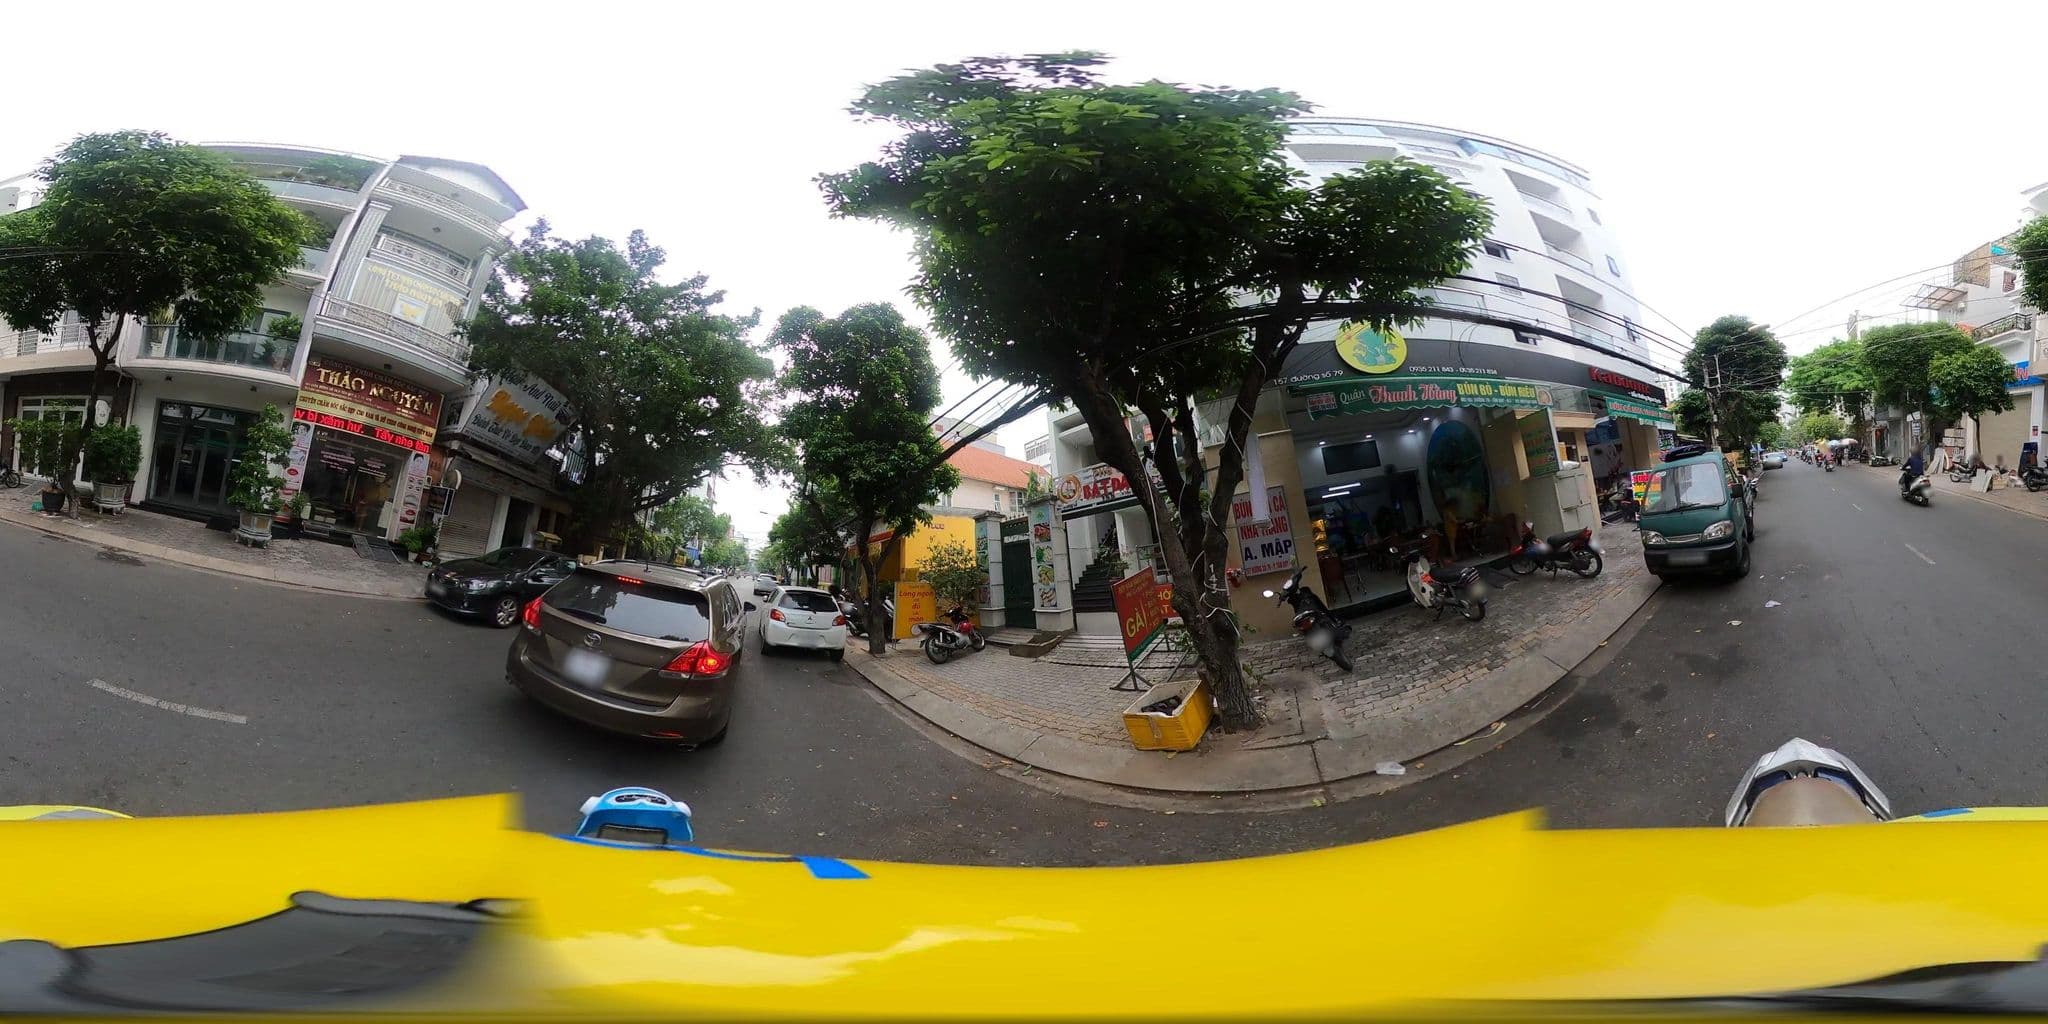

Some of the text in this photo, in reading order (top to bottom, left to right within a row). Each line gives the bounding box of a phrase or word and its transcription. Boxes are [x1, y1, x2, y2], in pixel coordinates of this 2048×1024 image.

[317, 368, 365, 392] THẢO
[370, 384, 433, 414] NGUYÊN
[1340, 388, 1366, 404] Quán
[1368, 384, 1418, 404] Thanh
[1457, 382, 1478, 396] BÚN
[1480, 382, 1492, 396] BÒ
[1500, 384, 1518, 396] BÚN
[1233, 498, 1253, 519] BÚN
[1273, 492, 1285, 512] CÁ
[1244, 538, 1292, 561] A. MẬP
[1126, 608, 1145, 638] GÀ
